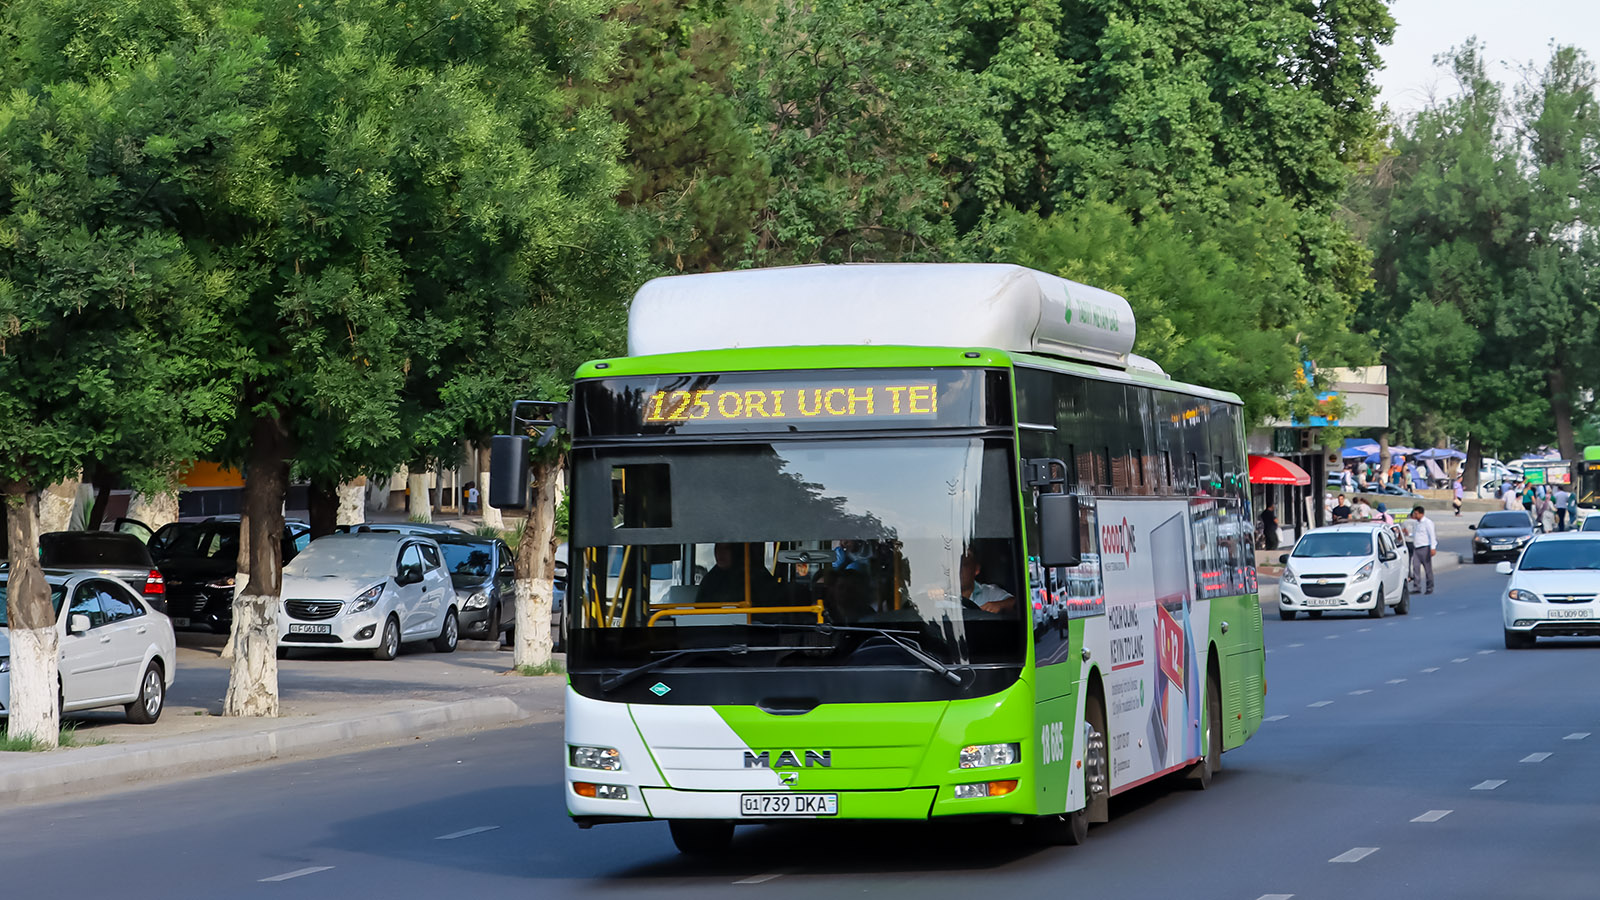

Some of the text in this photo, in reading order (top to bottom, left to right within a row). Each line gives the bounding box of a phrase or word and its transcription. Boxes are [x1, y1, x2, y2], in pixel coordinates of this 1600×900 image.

[647, 390, 715, 421] 125
[718, 390, 786, 419] ORI
[797, 387, 875, 416] UCH
[1041, 724, 1051, 766] 18
[743, 750, 831, 768] MAN
[745, 797, 827, 812] 01 739 DKA
